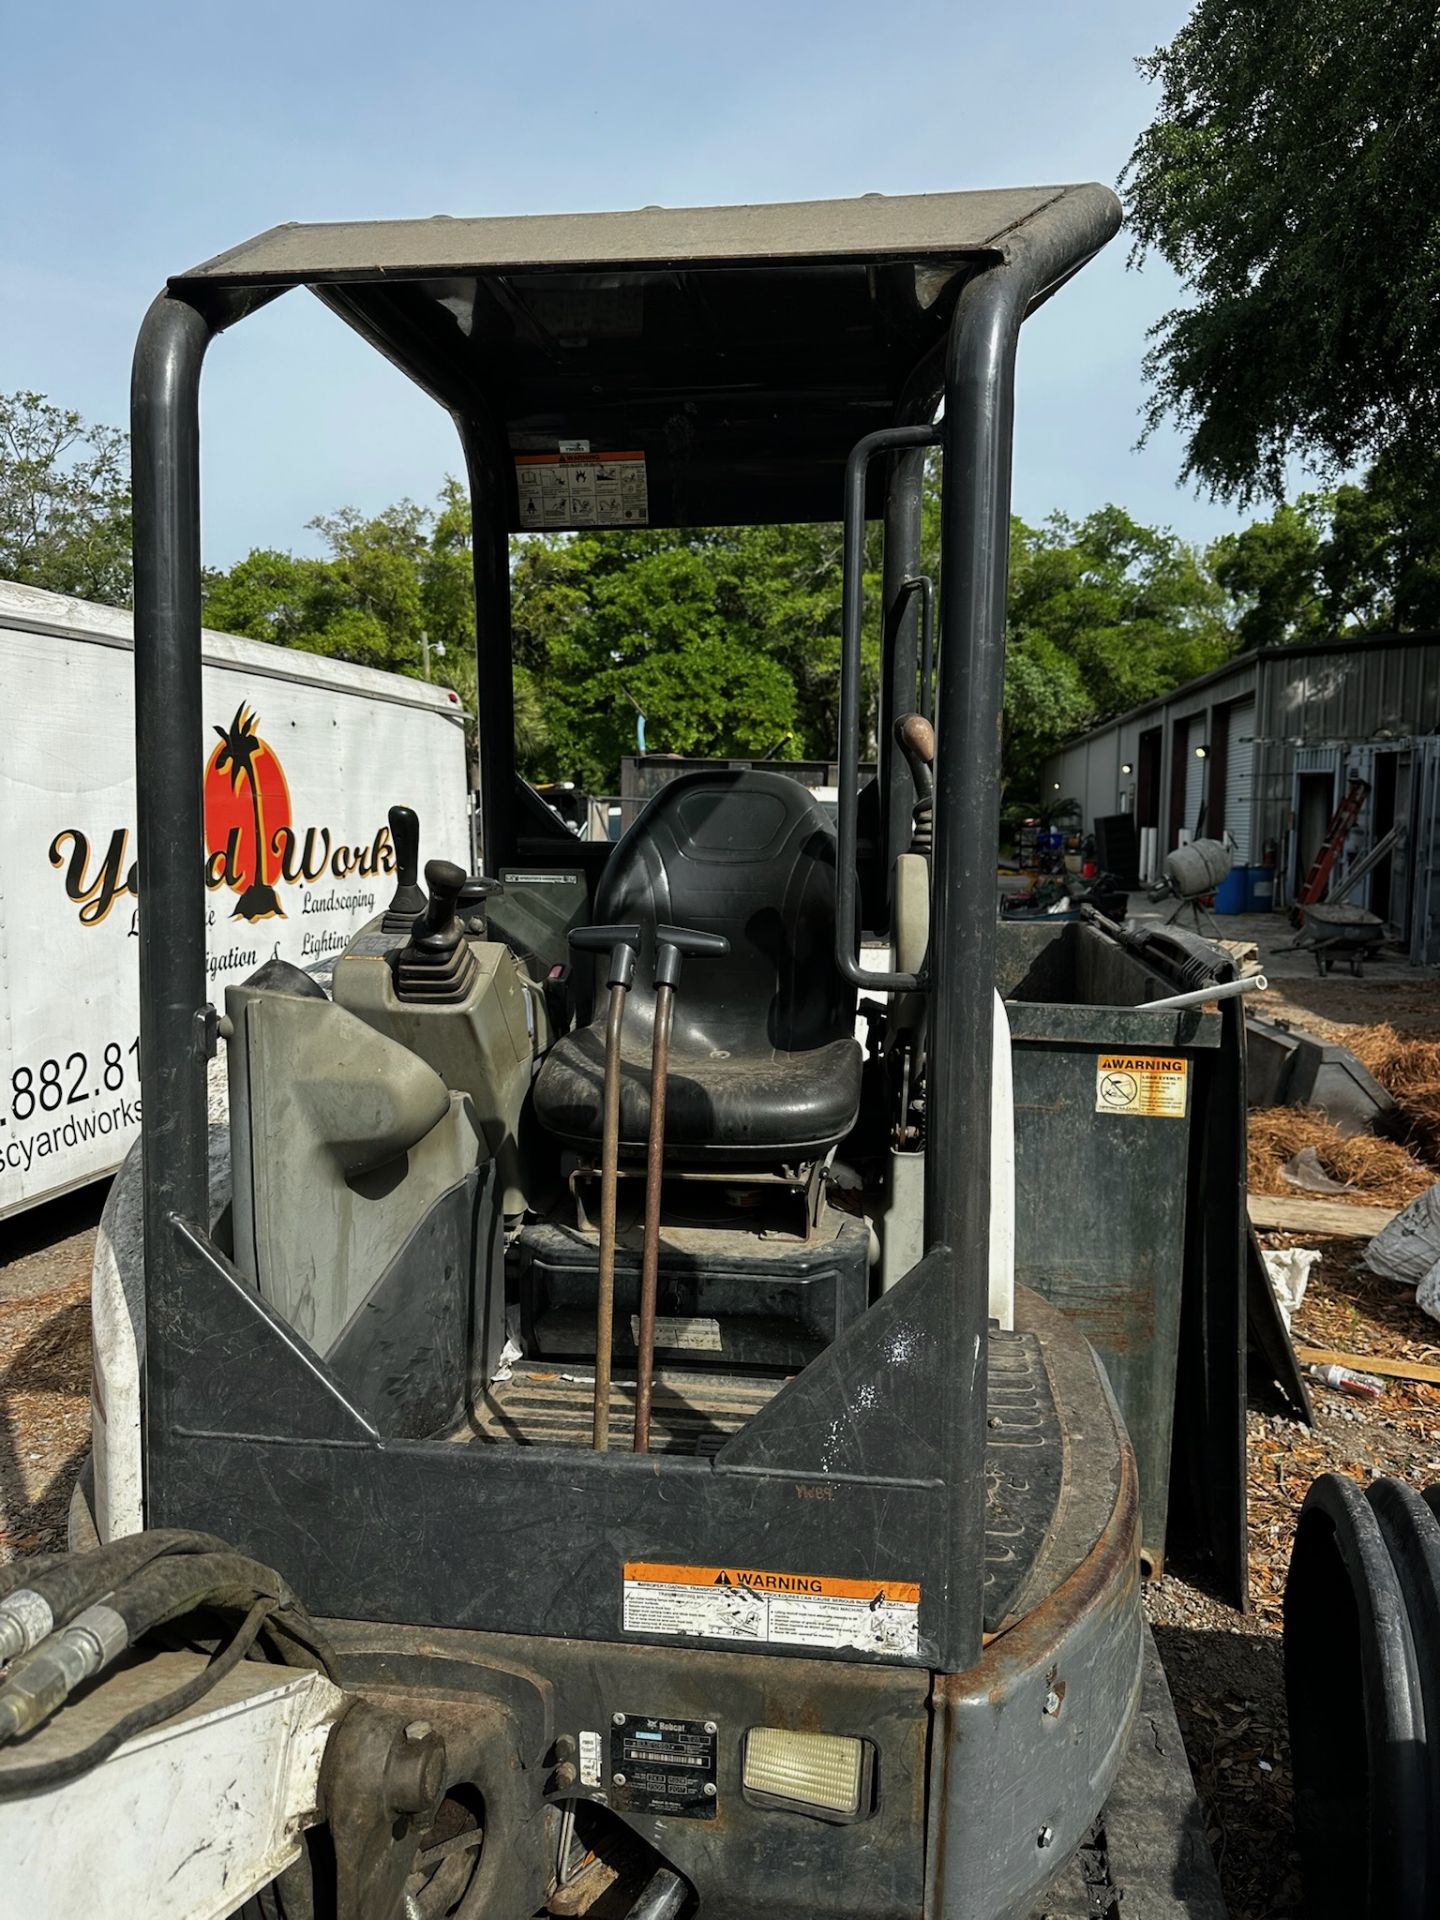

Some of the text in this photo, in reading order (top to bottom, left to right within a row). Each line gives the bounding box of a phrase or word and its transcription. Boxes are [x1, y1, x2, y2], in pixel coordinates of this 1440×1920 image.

[48, 826, 398, 927] Yd Work
[301, 890, 375, 916] Landscaping
[205, 946, 257, 982] igation
[1112, 1058, 1183, 1071] WARNING
[736, 1572, 823, 1593] WARNING
[659, 1722, 686, 1732] Bobcat
